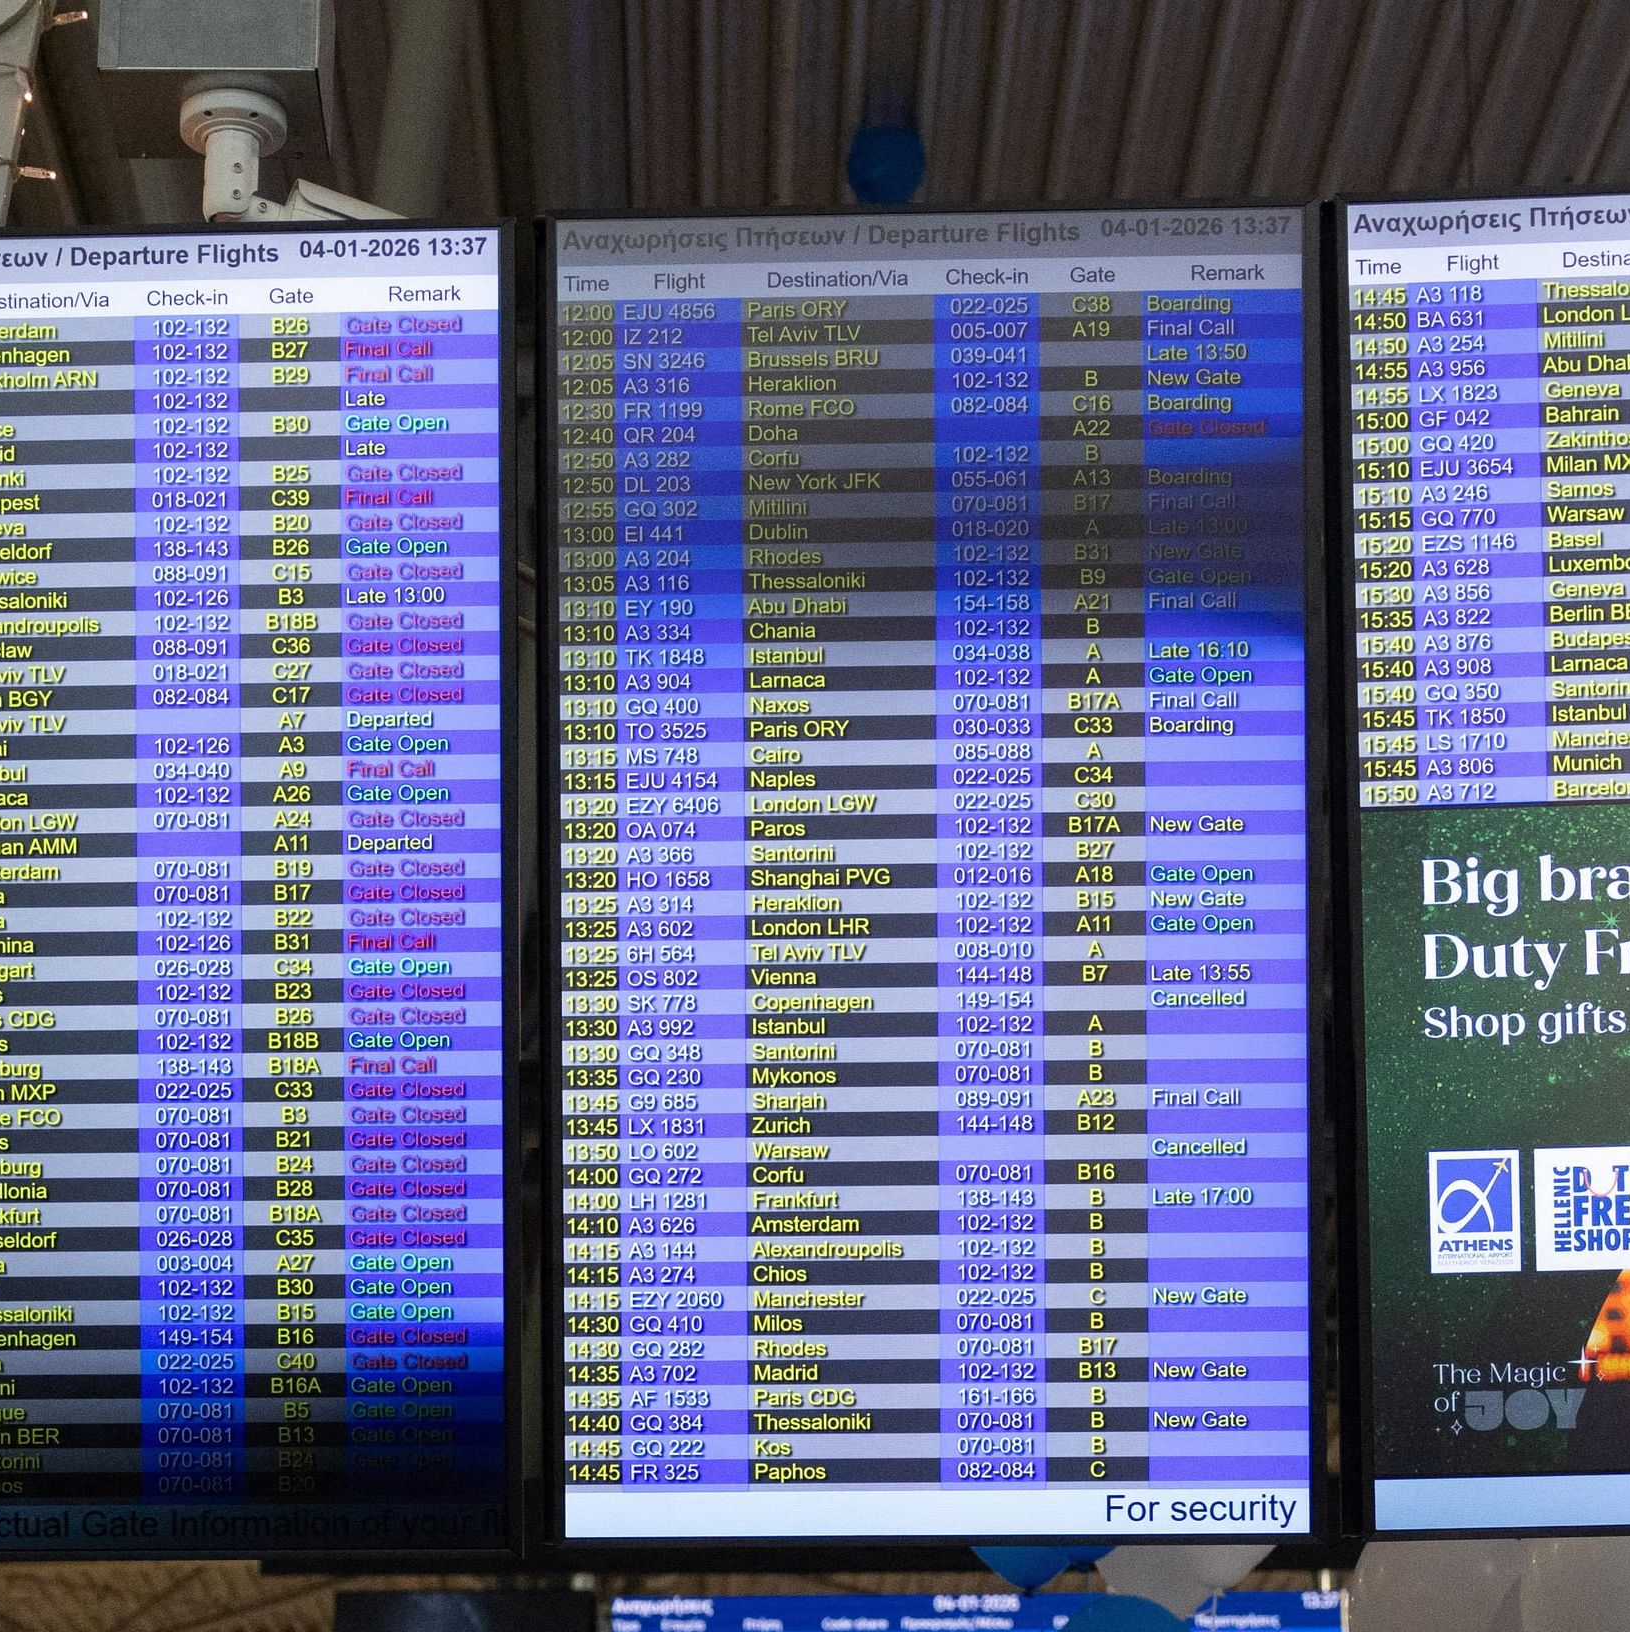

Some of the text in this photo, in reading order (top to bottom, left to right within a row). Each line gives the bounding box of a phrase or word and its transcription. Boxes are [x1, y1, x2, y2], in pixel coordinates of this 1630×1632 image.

[563, 228, 728, 255] Αναχωρήσεις
[737, 226, 846, 251] Πτήσεων
[868, 222, 988, 246] Departure
[997, 220, 1080, 245] Flights
[1101, 217, 1223, 238] 04-01-2026
[1233, 214, 1290, 234] 13:37
[1353, 212, 1521, 234] Αναχωρήσεις
[55, 247, 63, 267] /
[70, 245, 189, 267] Departure
[196, 242, 279, 267] Flights
[300, 239, 420, 259] 04-01-2026
[428, 237, 487, 256] 13:37
[1355, 256, 1401, 275] Time
[1446, 251, 1499, 274] Flight
[564, 262, 1264, 292] Time Flight Destination/Via Check-in Gate Remark
[146, 288, 229, 308] Check-in
[269, 287, 313, 304] Gate
[389, 283, 461, 302] Remark
[1355, 285, 1407, 305] 14:45
[1416, 284, 1443, 303] A3
[1451, 283, 1483, 302] 118
[152, 318, 229, 337] 102-132
[271, 317, 309, 335] B26
[346, 315, 390, 334] Gate
[397, 314, 461, 333] Closed
[564, 468, 1232, 495] 12:50 DL 203 New York JFK 055-061 A13 Boarding
[1363, 707, 1415, 727] 15:45
[1426, 707, 1452, 726] TK
[1461, 706, 1506, 725] 1850
[1551, 703, 1628, 723] Istanbul
[1421, 856, 1519, 916] Big
[1424, 931, 1566, 991] Duty
[1424, 1006, 1527, 1046] Shop
[1538, 1002, 1626, 1045] gifts
[567, 1137, 1246, 1162] 13:50 LO 602 Warsaw Cancelled
[1552, 1165, 1572, 1253] HELLENIC
[1438, 1238, 1513, 1252] ATHENS
[157, 1254, 233, 1273] 003-004
[277, 1254, 313, 1272] A27
[349, 1253, 395, 1272] Gate
[401, 1253, 452, 1275] Open
[568, 1360, 1247, 1384] 14:35 A3 702 Madrid 102-132 B13 New Gate
[1433, 1362, 1566, 1387] The Magic
[1434, 1388, 1586, 1429] of JOY
[1106, 1494, 1297, 1527] For security
[81, 1510, 159, 1538] Gate
[170, 1509, 351, 1539] Information
